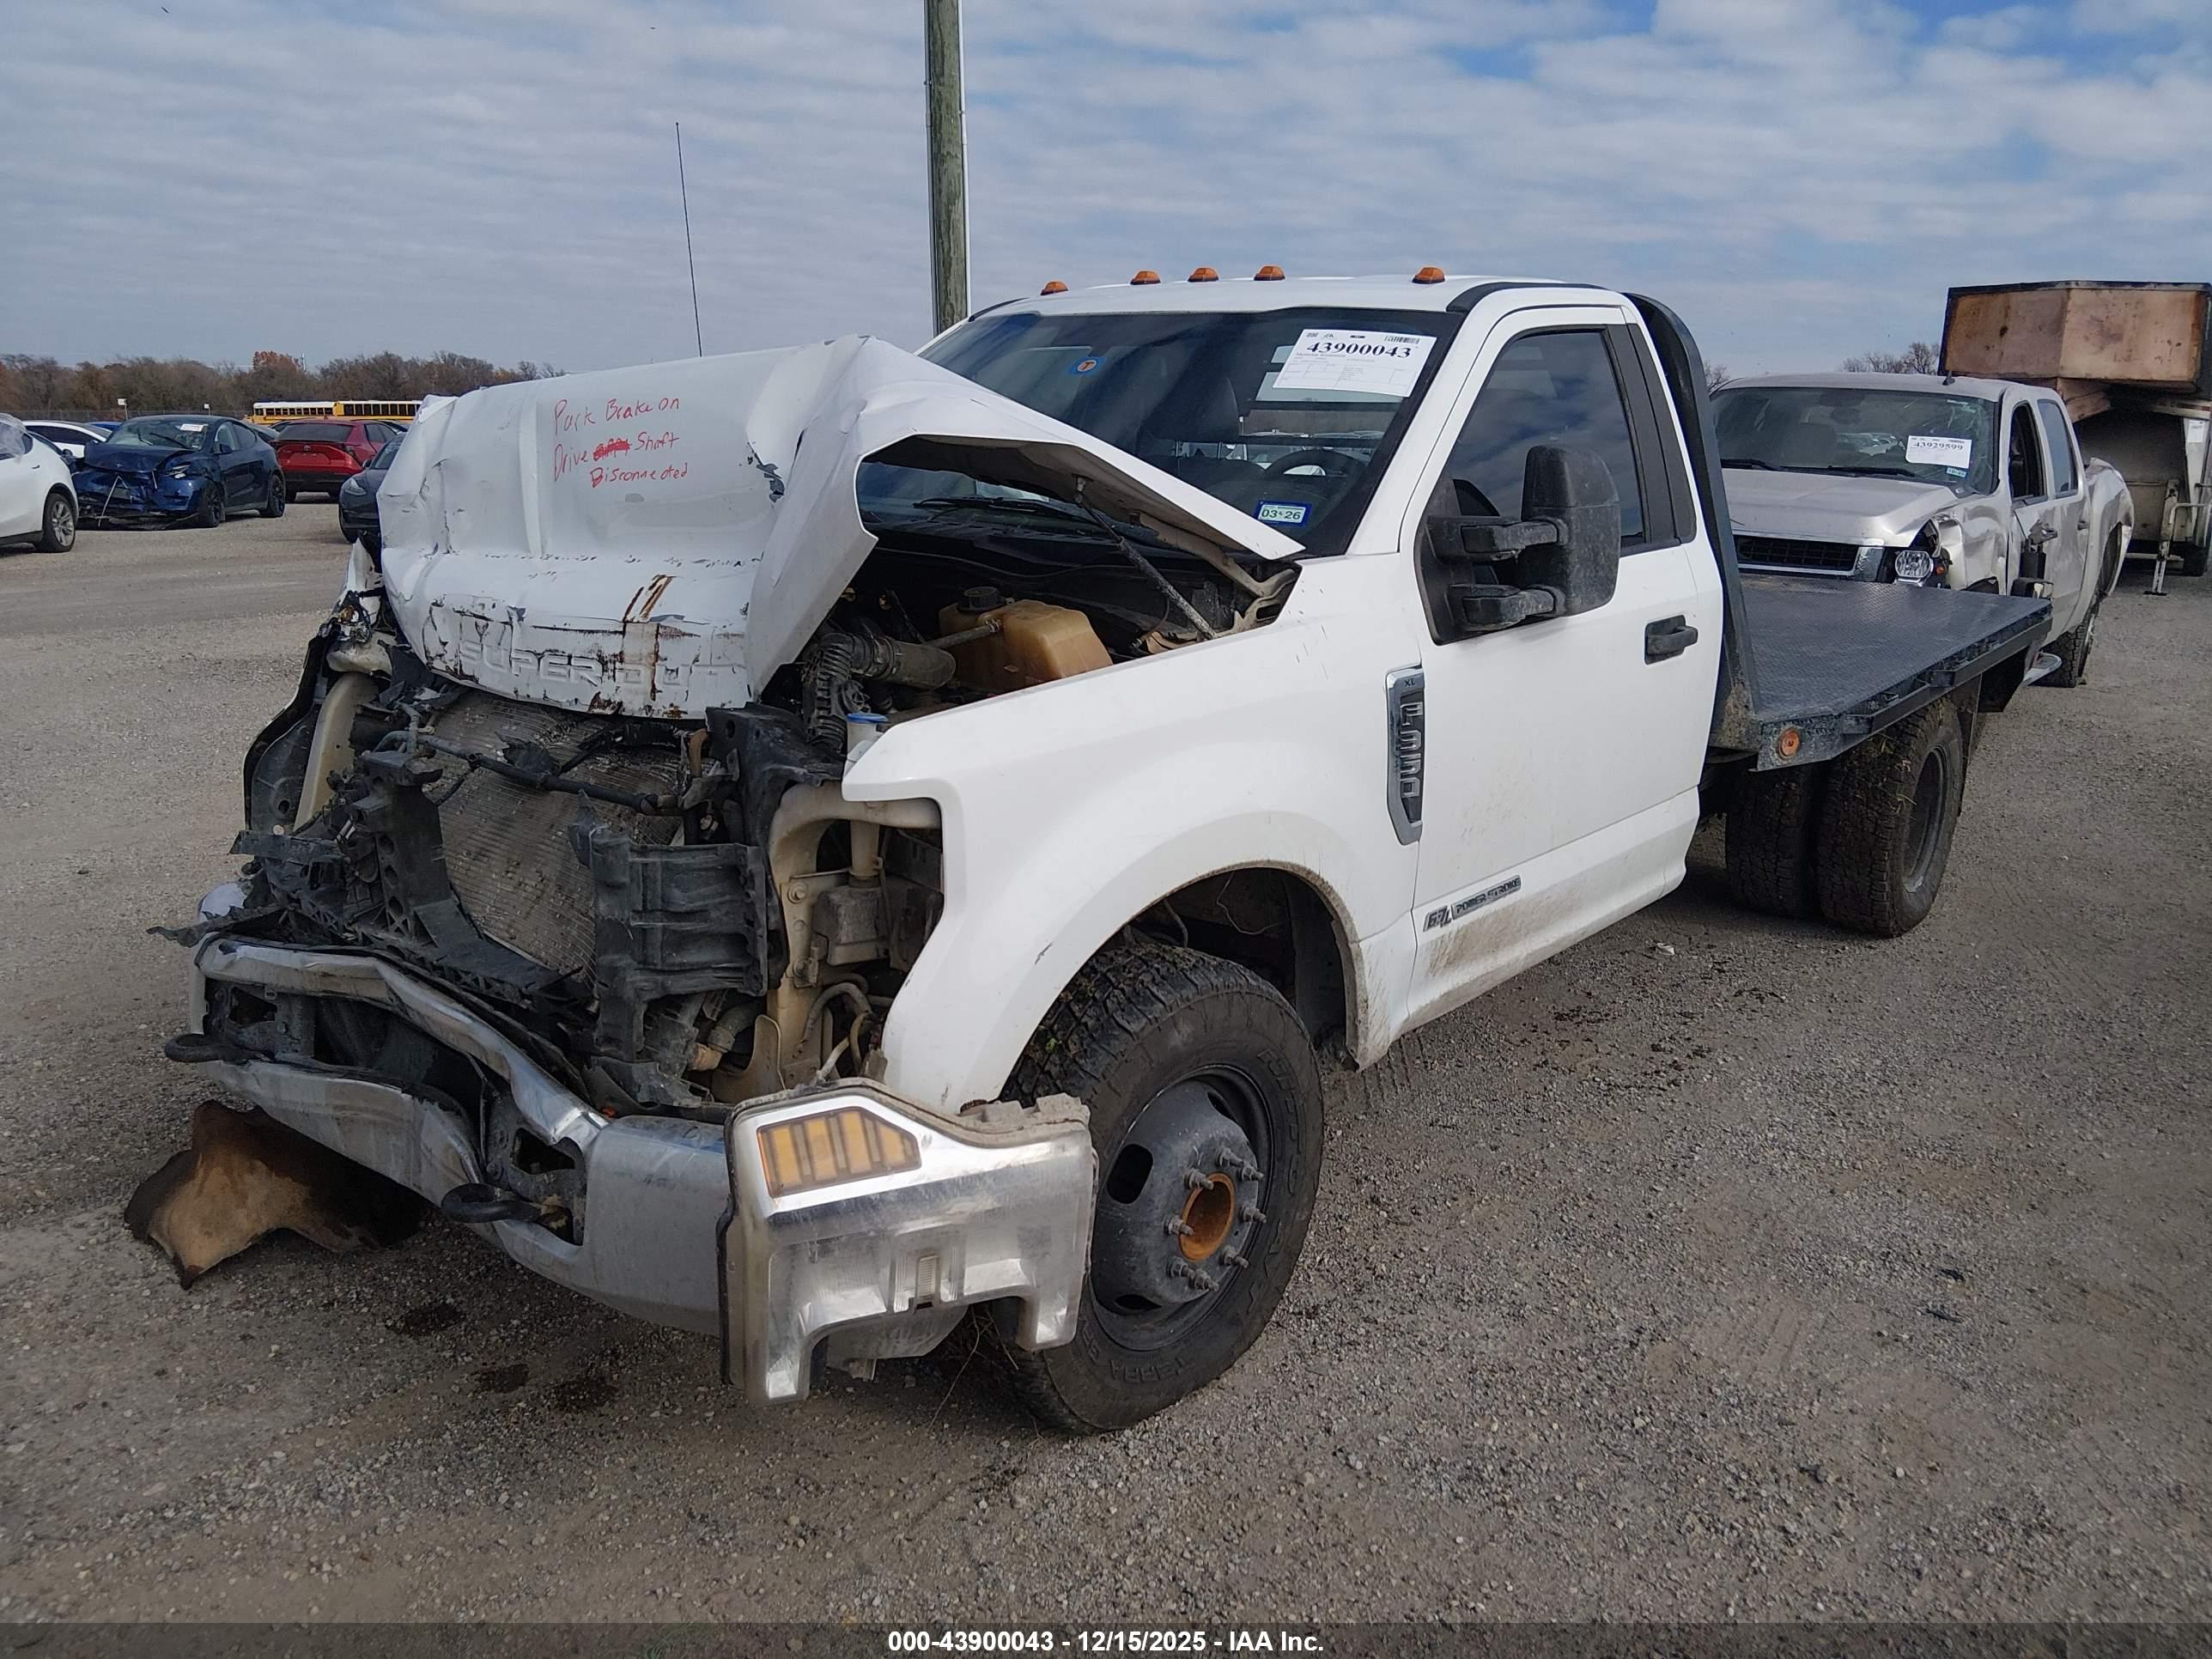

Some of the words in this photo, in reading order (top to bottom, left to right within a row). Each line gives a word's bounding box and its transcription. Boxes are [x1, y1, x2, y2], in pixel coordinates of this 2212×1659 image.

[1306, 342, 1412, 359] 43900043
[555, 399, 595, 435] Park
[605, 398, 653, 421] Brake
[554, 444, 588, 482] Drive
[635, 432, 680, 451] Shaft
[1261, 509, 1278, 518] 03
[1285, 511, 1301, 520] 26
[459, 639, 602, 687] SUPER
[1487, 877, 1522, 899] STROKE
